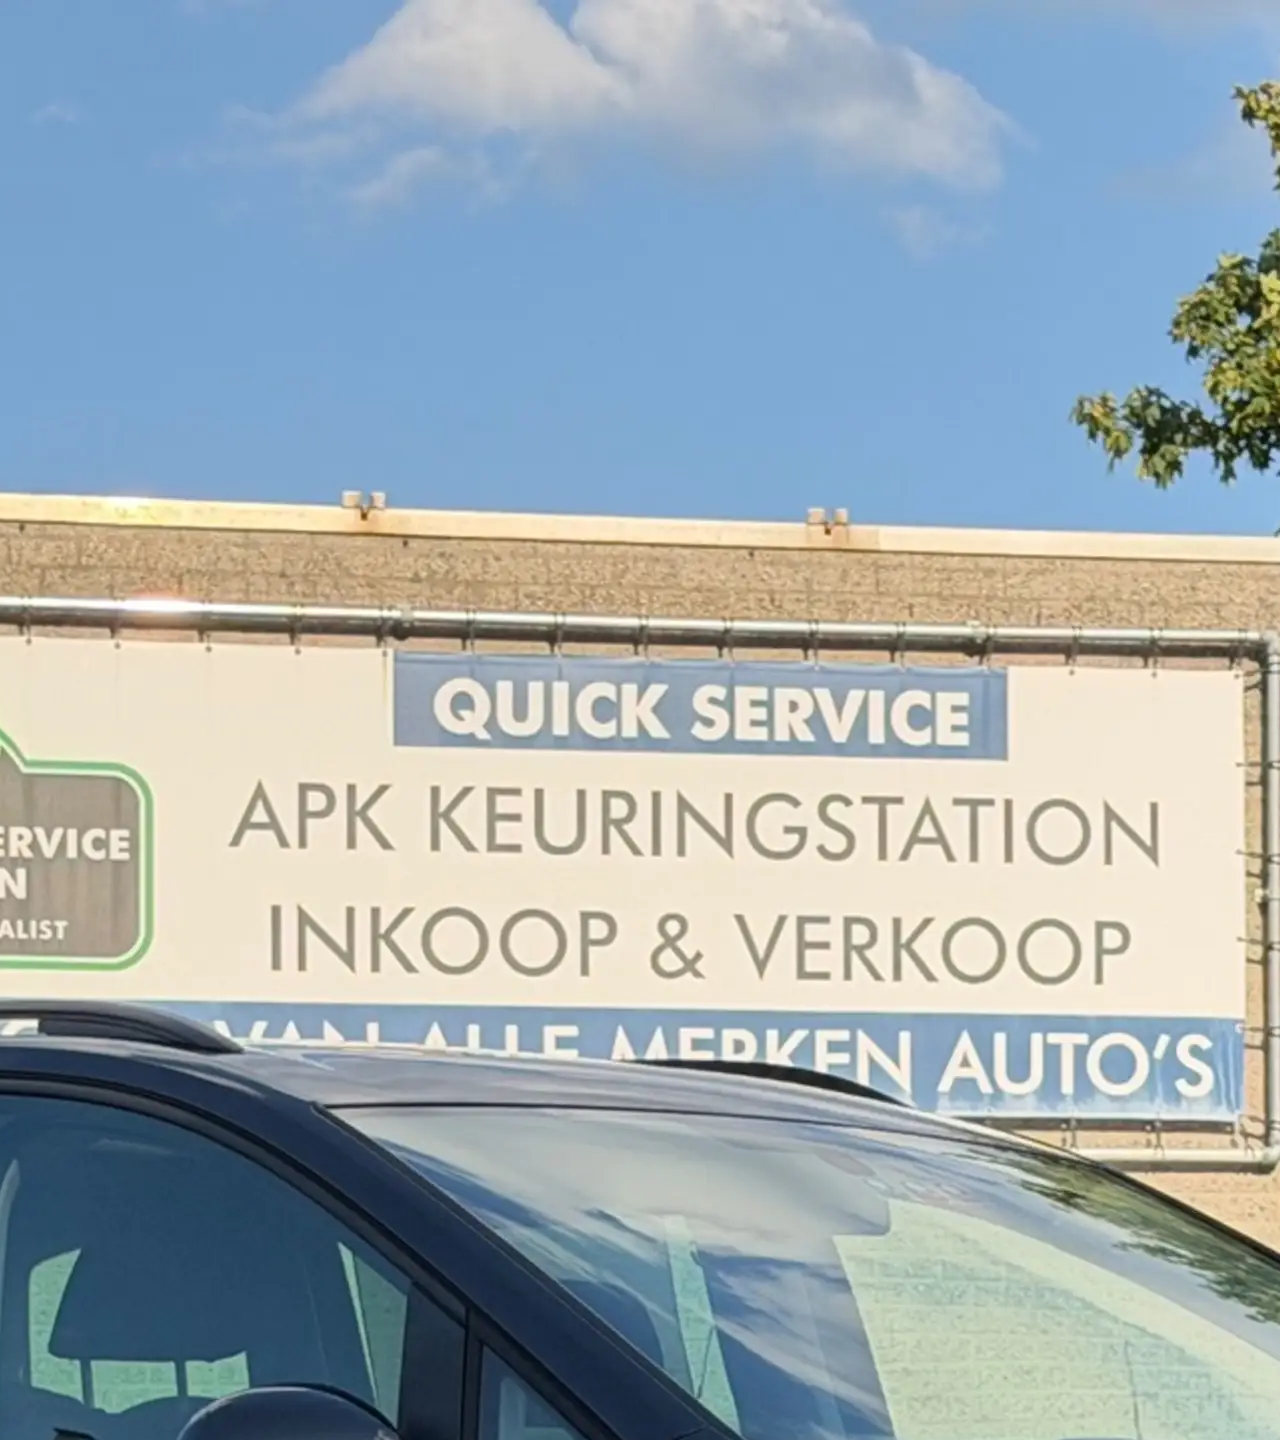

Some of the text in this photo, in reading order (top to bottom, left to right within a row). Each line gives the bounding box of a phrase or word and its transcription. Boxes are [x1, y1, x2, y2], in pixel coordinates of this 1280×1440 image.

[433, 677, 970, 746] QUICK SERVICE
[228, 780, 1159, 867] APK KEURINGSTATION
[270, 904, 1131, 986] INKOOP & VERKOOP
[936, 1029, 1215, 1098] AUTO'S
